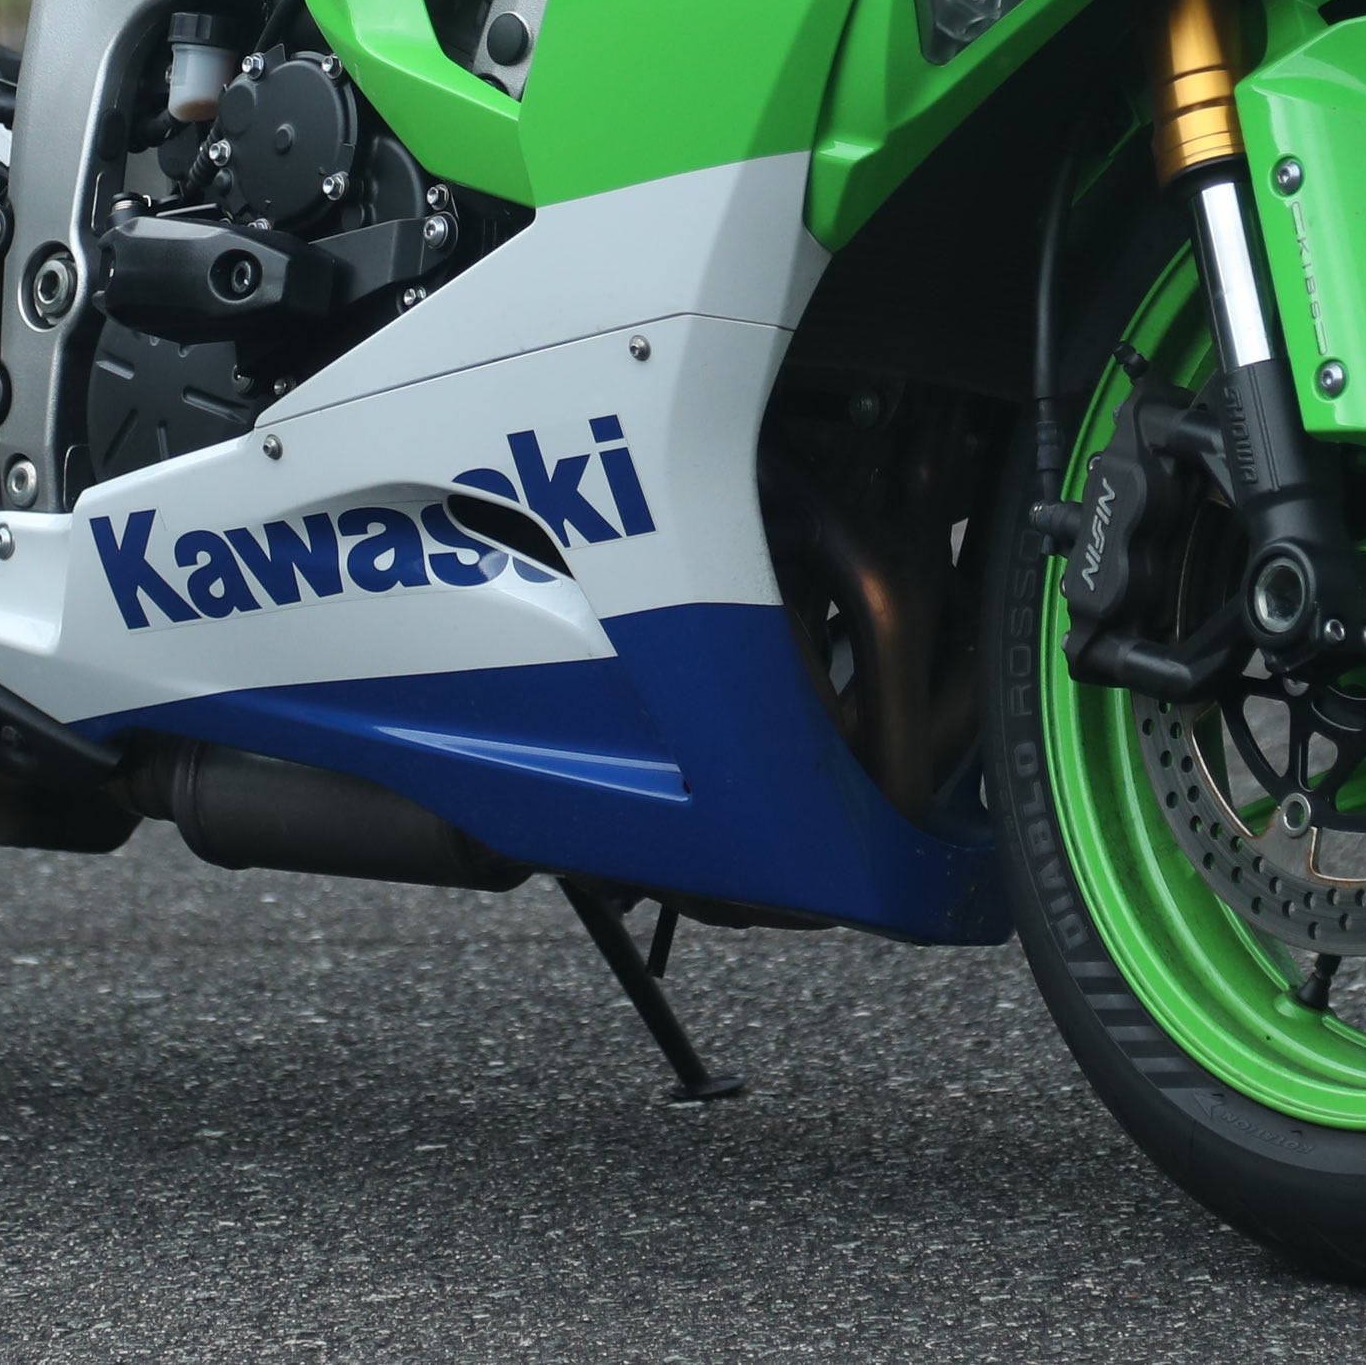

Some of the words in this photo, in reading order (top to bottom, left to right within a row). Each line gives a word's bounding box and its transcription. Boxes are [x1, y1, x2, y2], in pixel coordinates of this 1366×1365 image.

[1008, 529, 1043, 717] ROSSO
[1081, 476, 1116, 592] NISSIN
[1013, 739, 1090, 952] DIABLO
